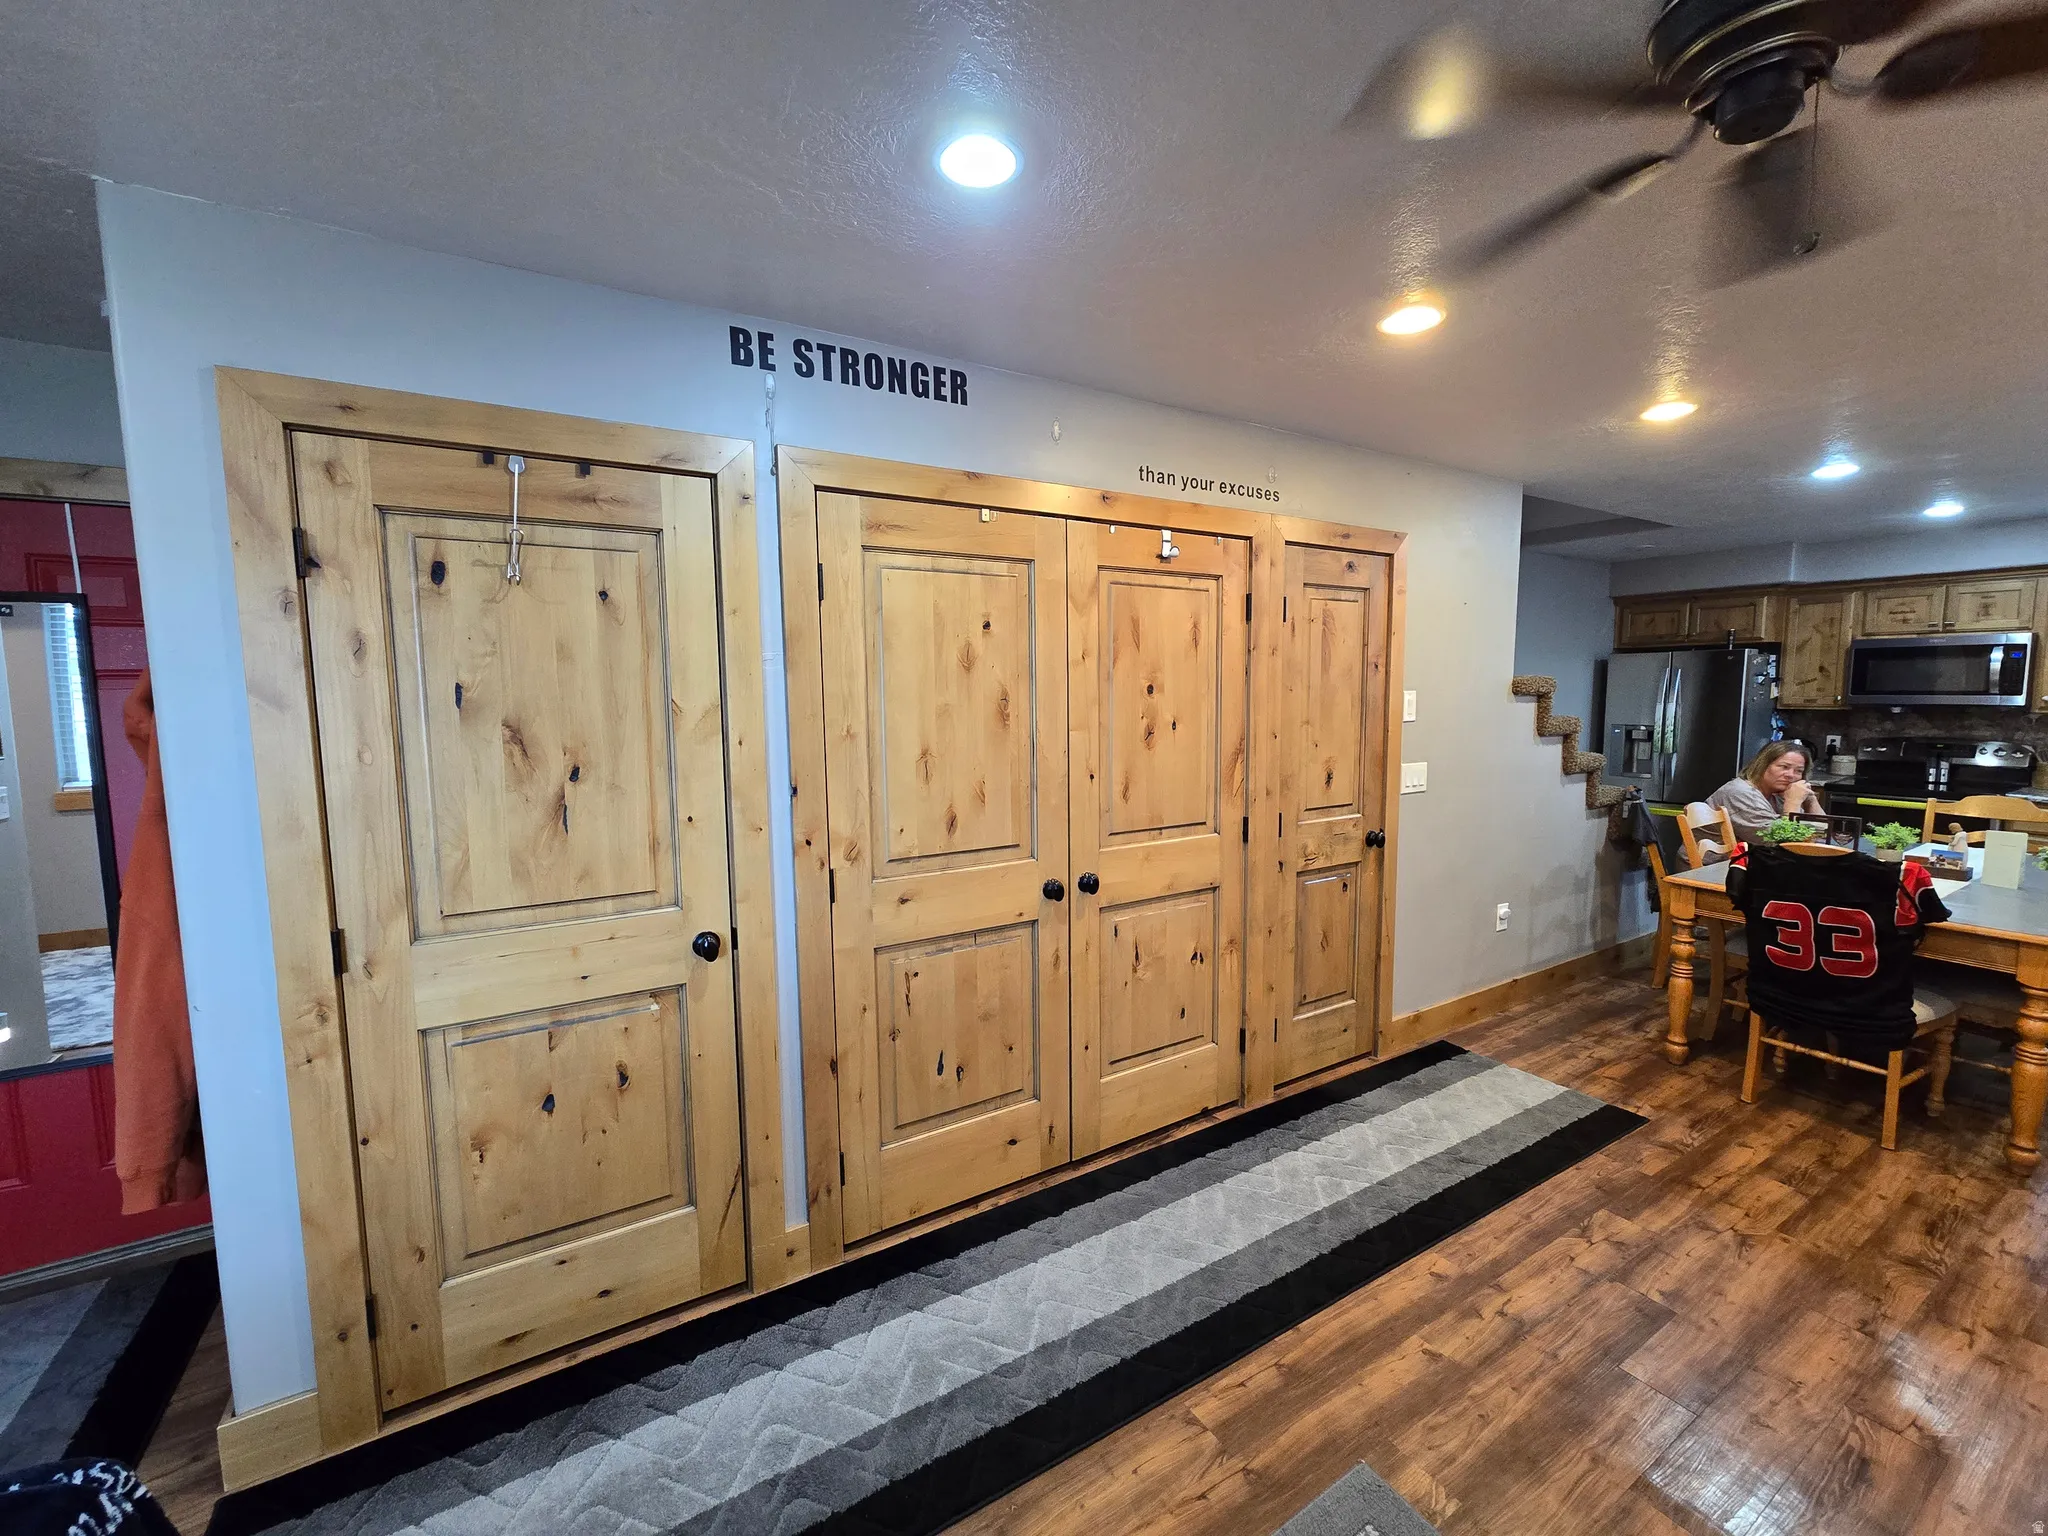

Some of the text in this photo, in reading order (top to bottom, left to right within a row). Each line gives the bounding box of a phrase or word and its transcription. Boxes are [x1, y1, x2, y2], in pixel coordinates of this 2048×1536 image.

[729, 325, 968, 406] BE STRONGER
[1138, 465, 1280, 502] than your excuses
[1762, 900, 1878, 978] 33
